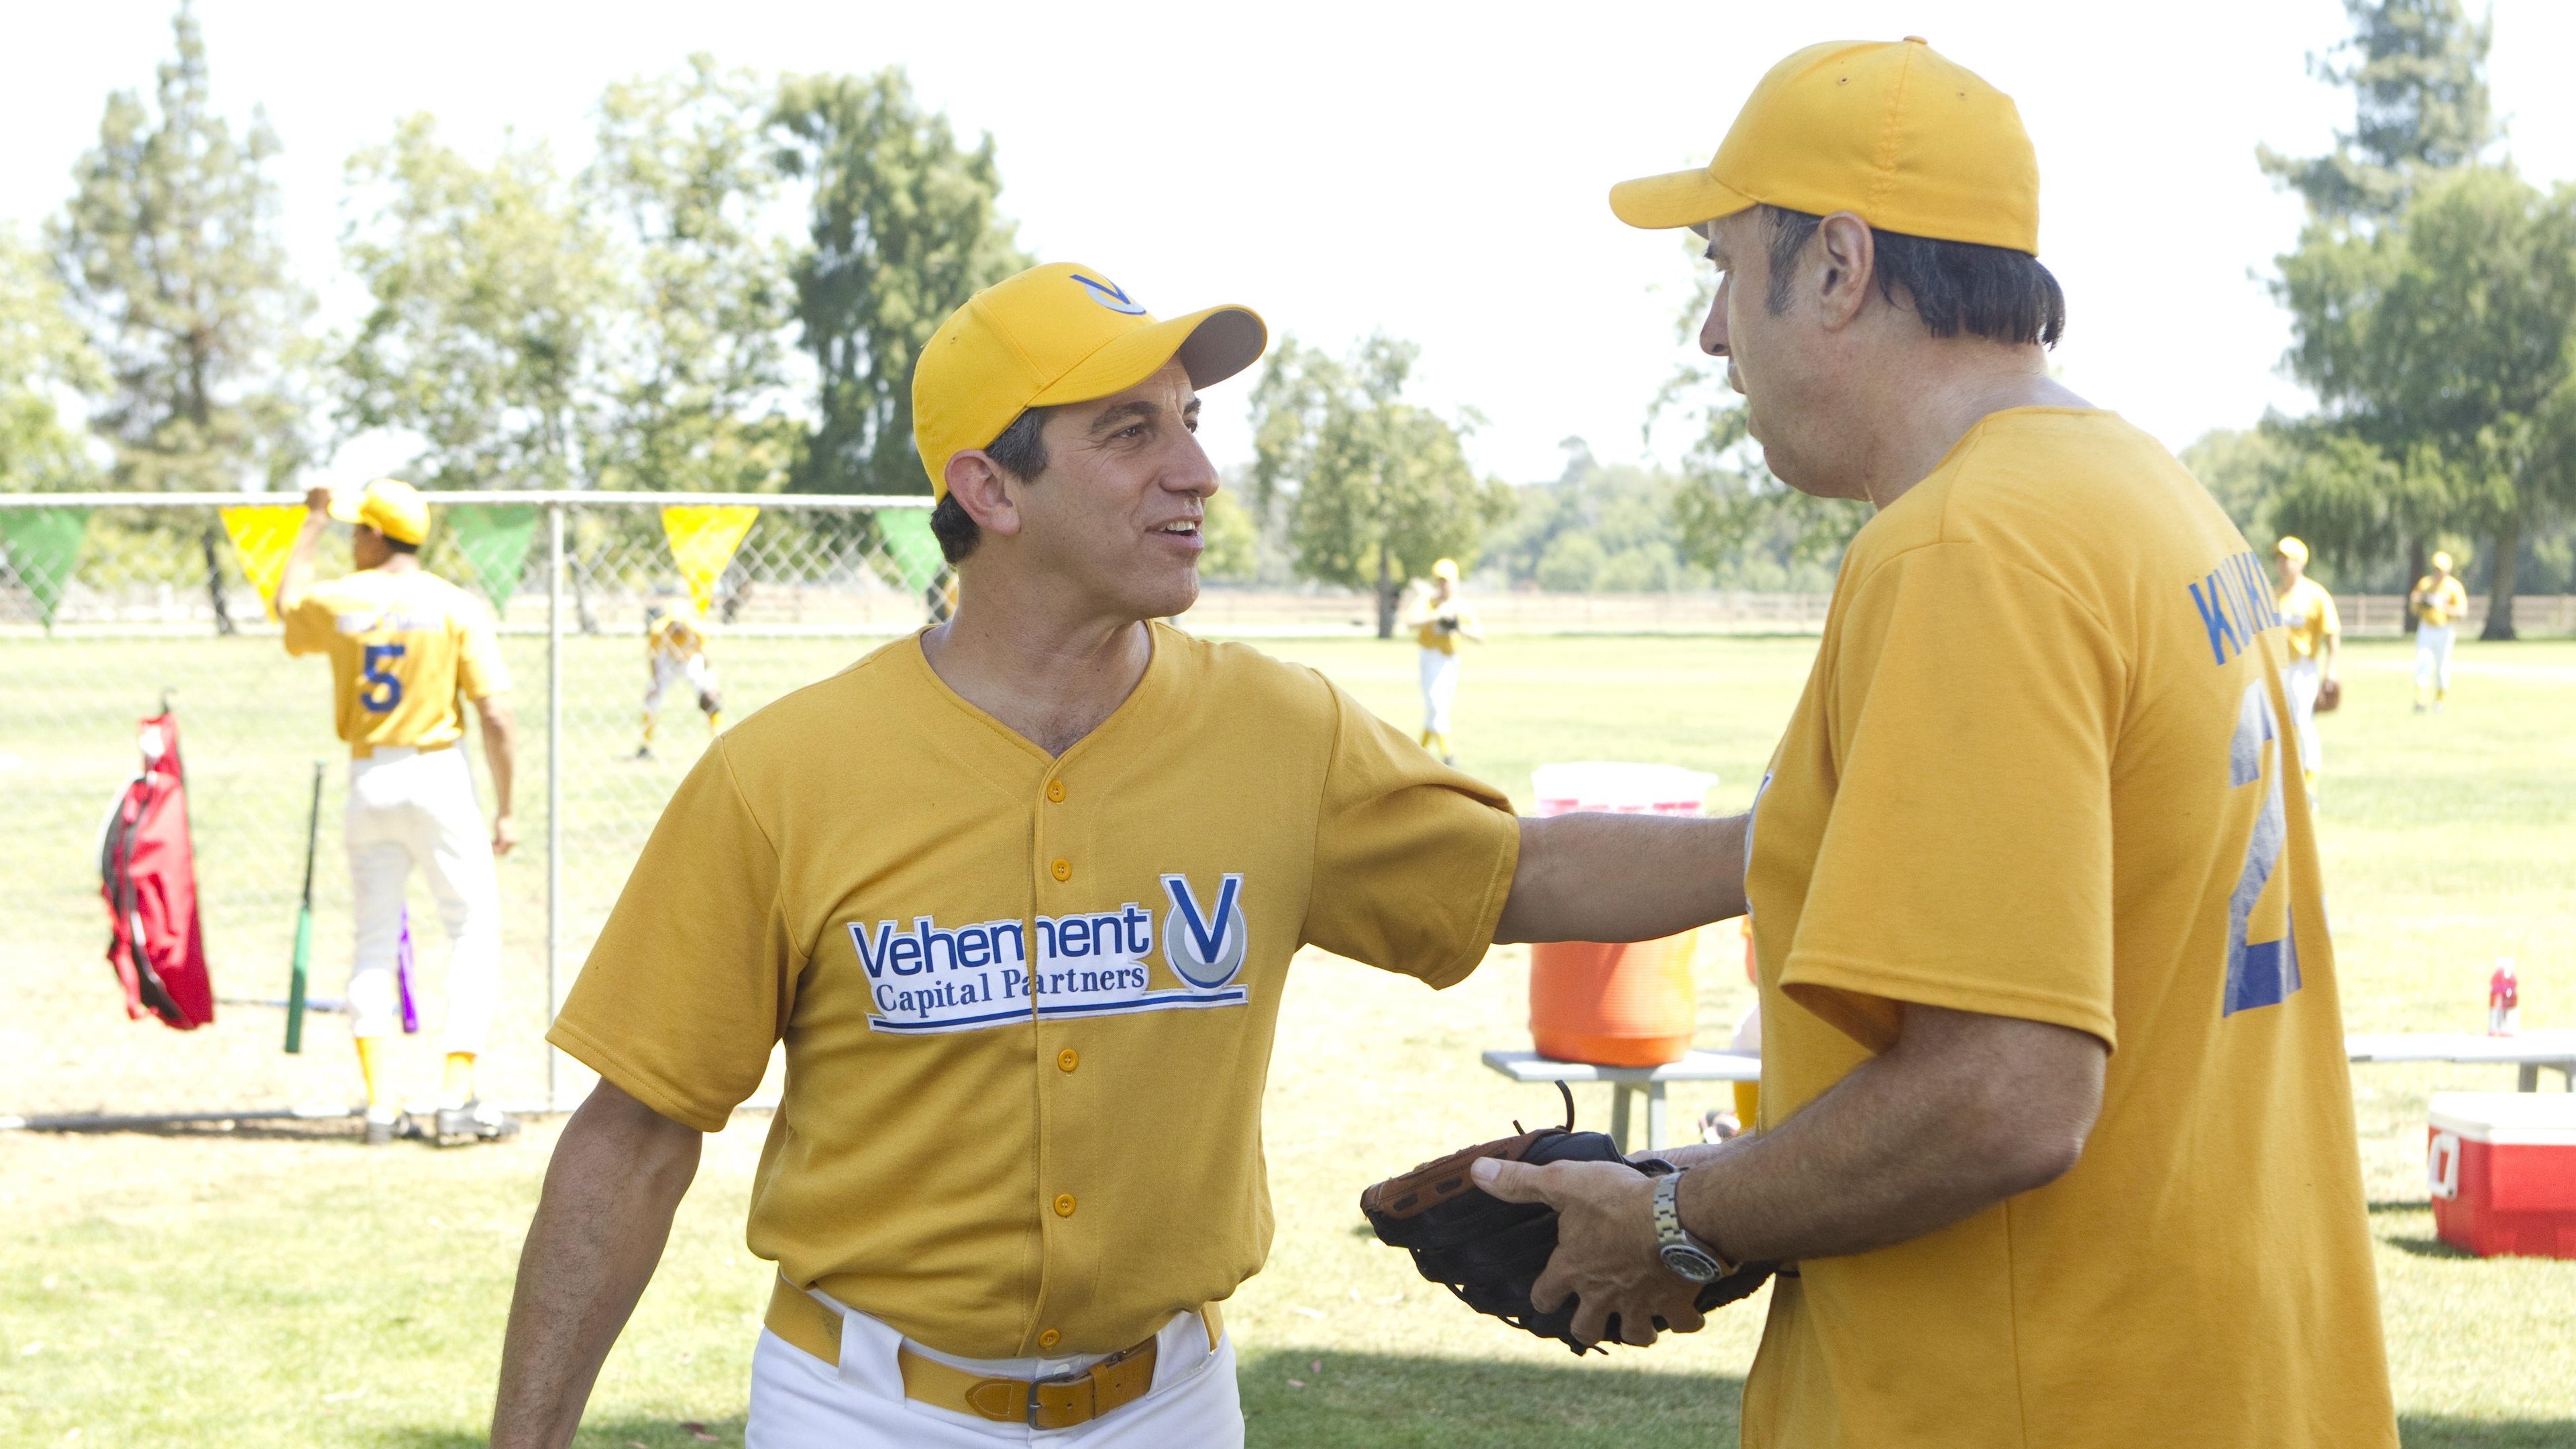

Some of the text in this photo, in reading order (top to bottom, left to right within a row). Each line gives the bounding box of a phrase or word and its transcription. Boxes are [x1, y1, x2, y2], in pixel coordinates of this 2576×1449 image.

[360, 644, 406, 713] 5
[2222, 671, 2302, 1018] 2
[853, 908, 1150, 978] Vehement
[1168, 878, 1238, 963] V
[875, 967, 1145, 1018] Capital Partners
